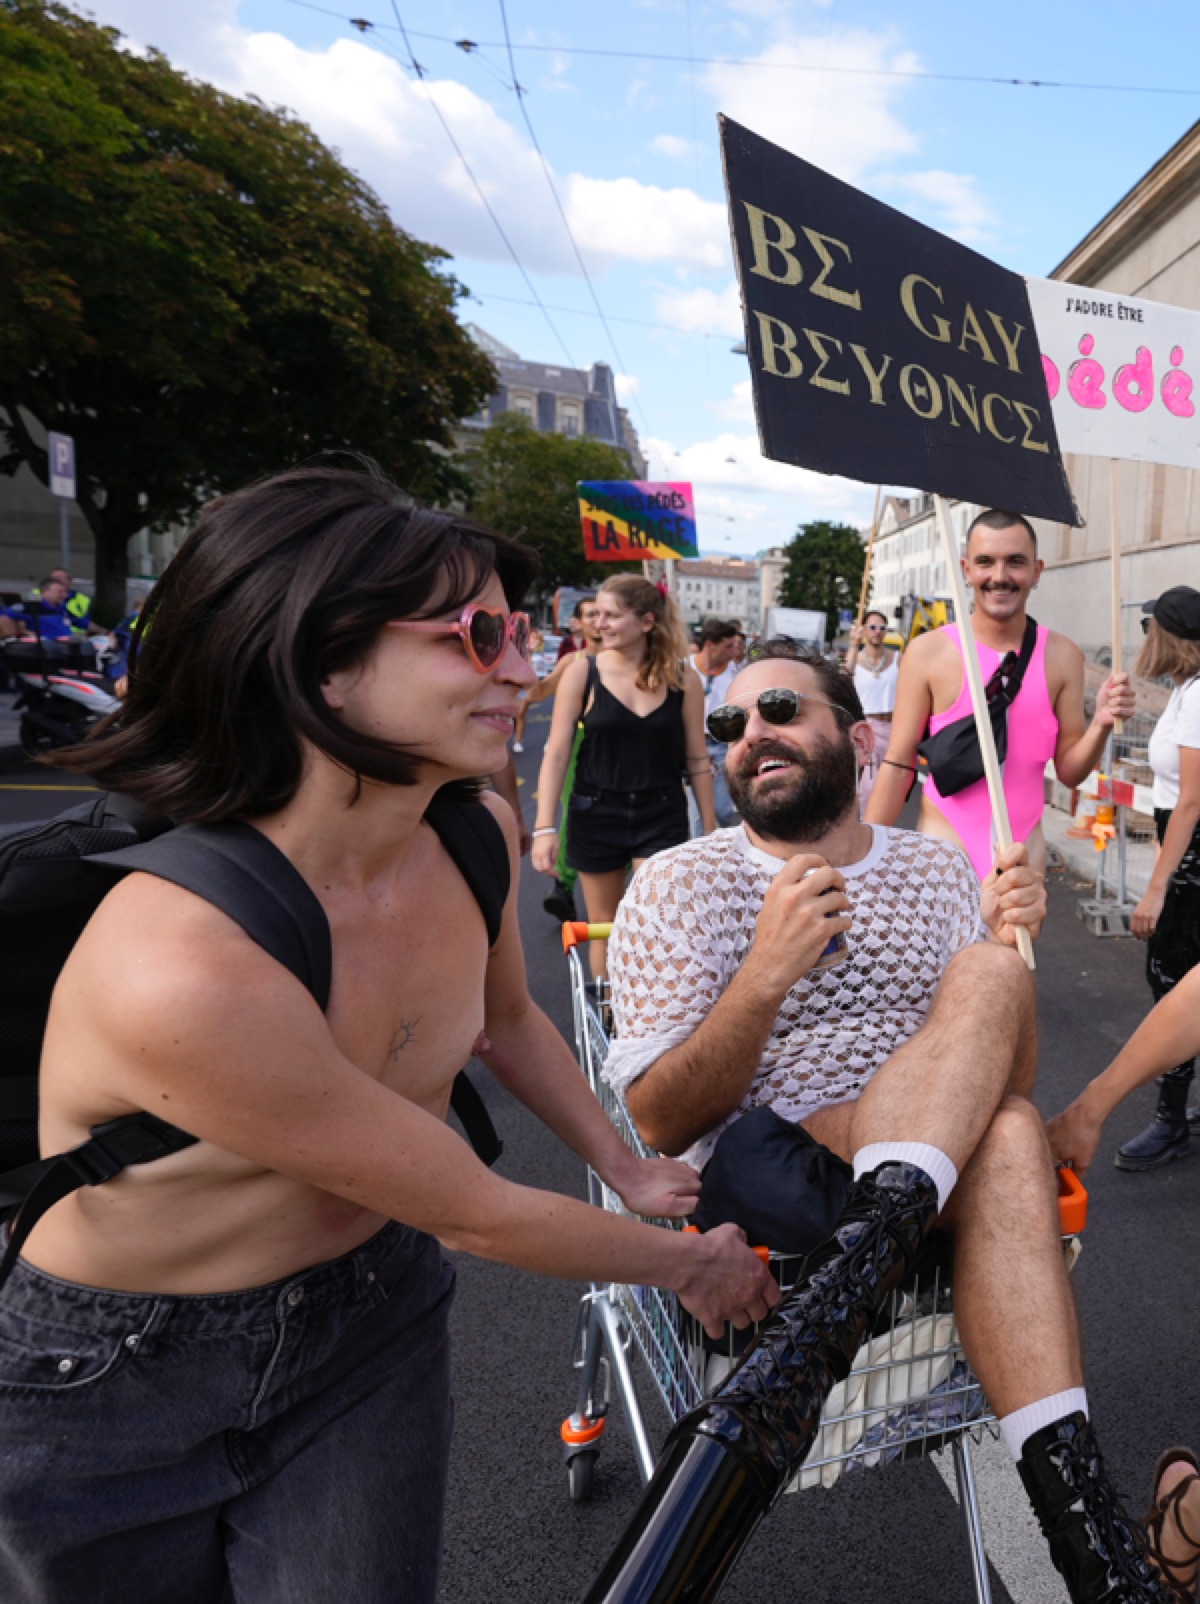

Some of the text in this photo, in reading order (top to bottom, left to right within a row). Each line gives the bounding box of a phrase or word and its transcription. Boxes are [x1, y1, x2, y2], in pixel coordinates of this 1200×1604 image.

[900, 273, 1026, 374] GAY
[1066, 298, 1144, 323] J'ADORE ÊTRE
[56, 442, 69, 473] P
[591, 516, 690, 550] LA RAGE
